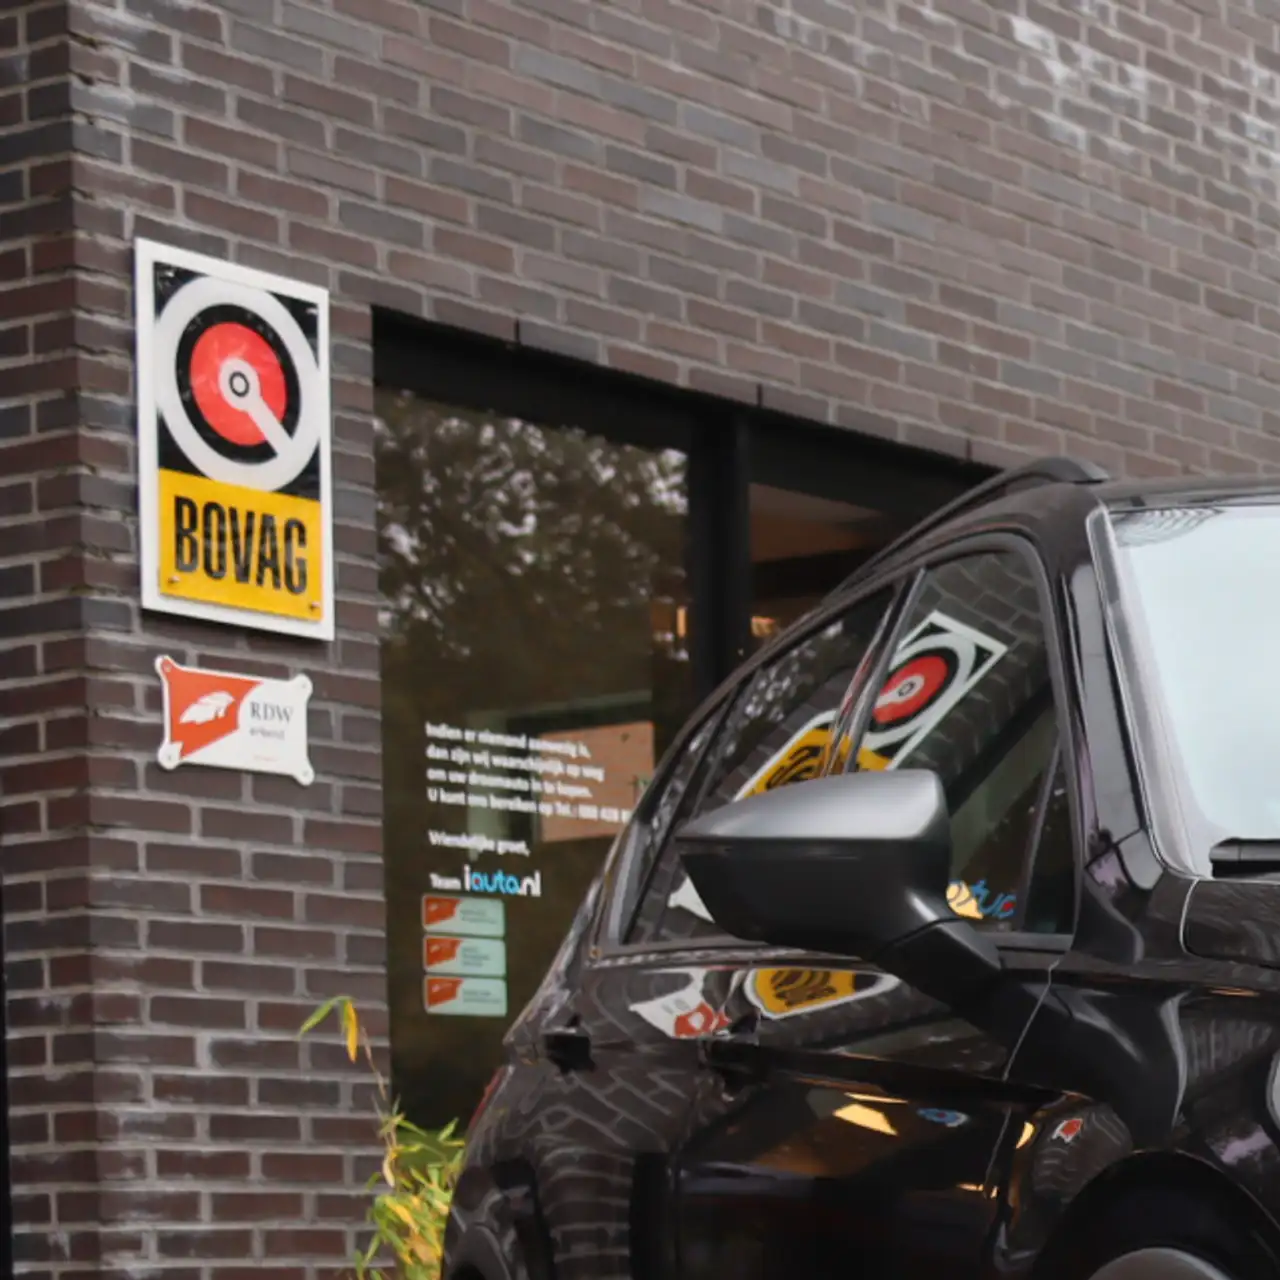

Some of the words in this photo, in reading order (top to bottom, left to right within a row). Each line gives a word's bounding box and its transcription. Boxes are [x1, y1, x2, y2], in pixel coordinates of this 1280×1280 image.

[174, 495, 307, 595] BOVAG
[250, 701, 295, 724] RDW
[427, 787, 438, 802] U
[464, 863, 542, 898] iauto.nl
